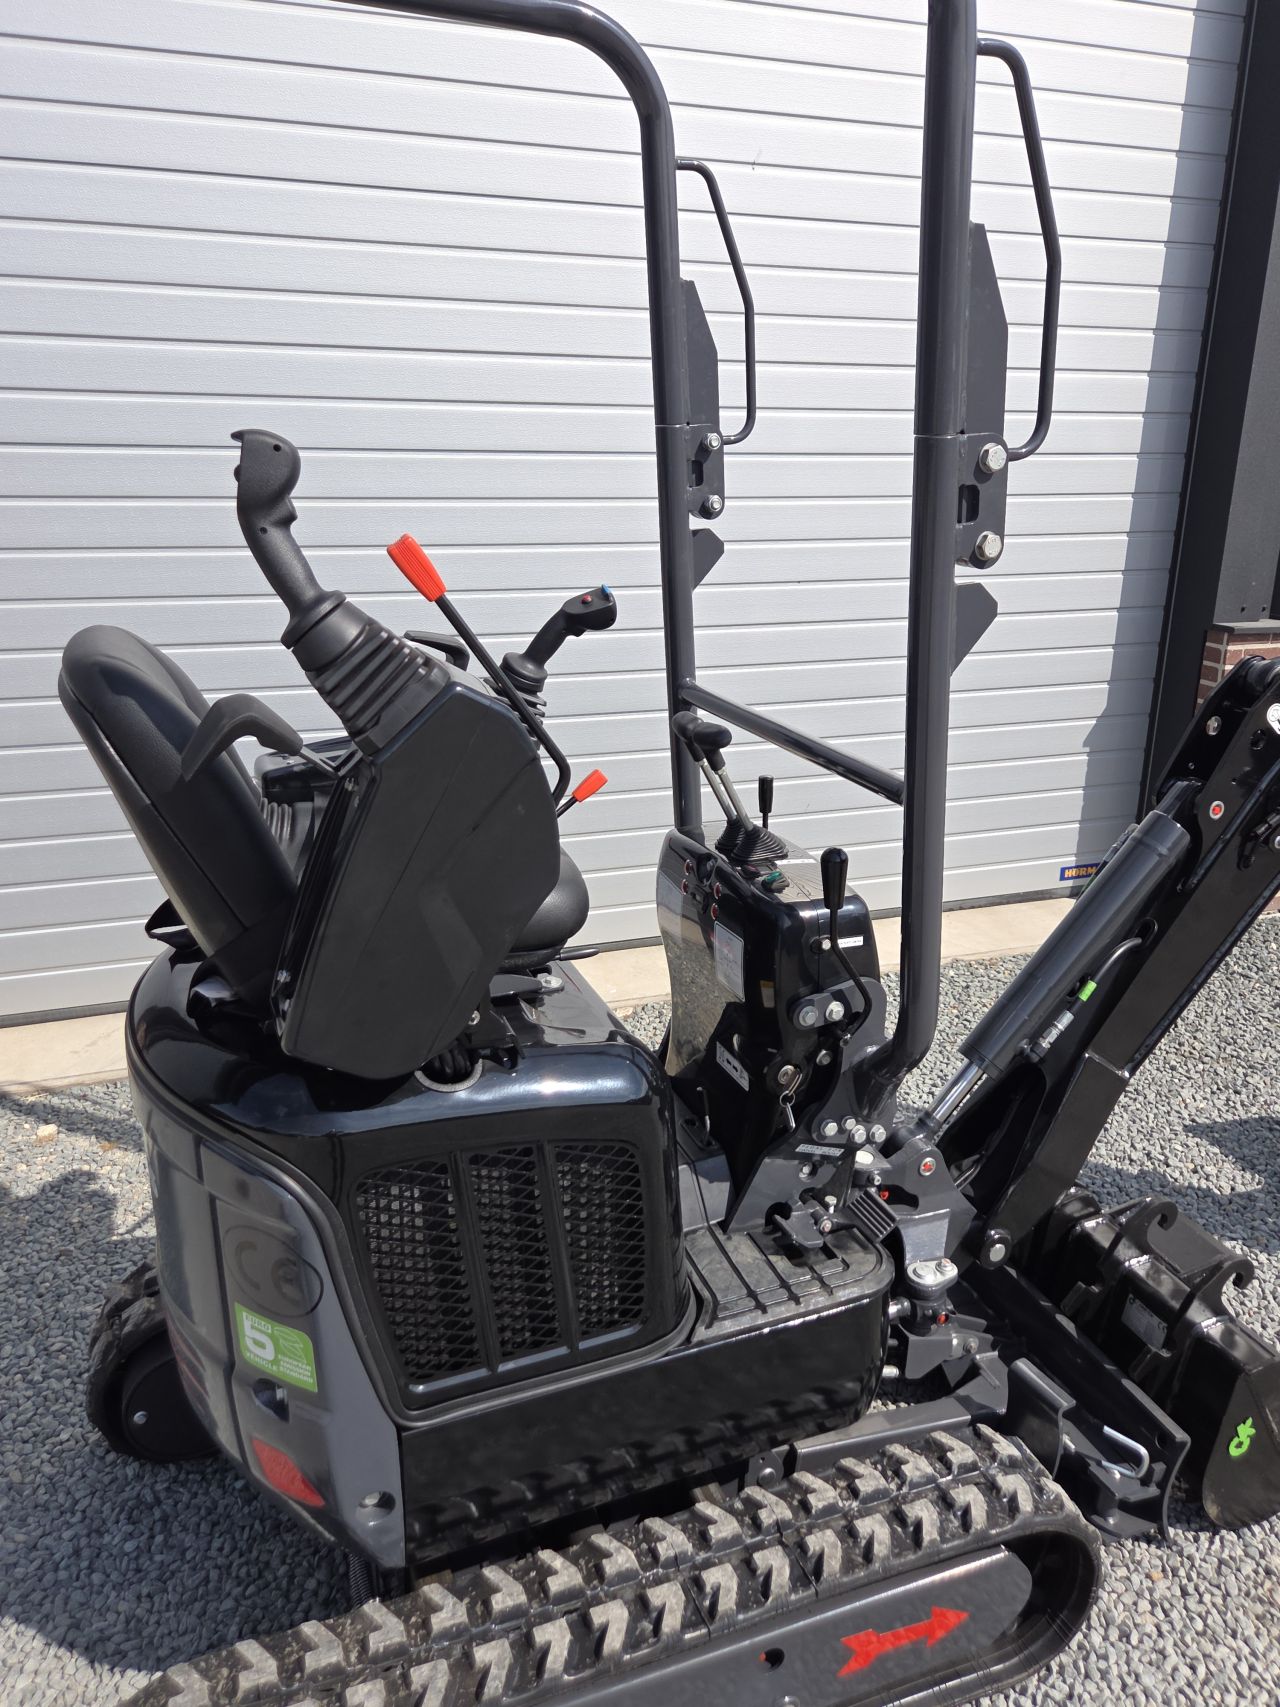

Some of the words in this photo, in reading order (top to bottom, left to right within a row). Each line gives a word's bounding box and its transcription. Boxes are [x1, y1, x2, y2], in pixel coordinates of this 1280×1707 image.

[245, 1314, 270, 1332] EURO
[243, 1312, 275, 1361] 5
[246, 1352, 277, 1371] VEHICLE
